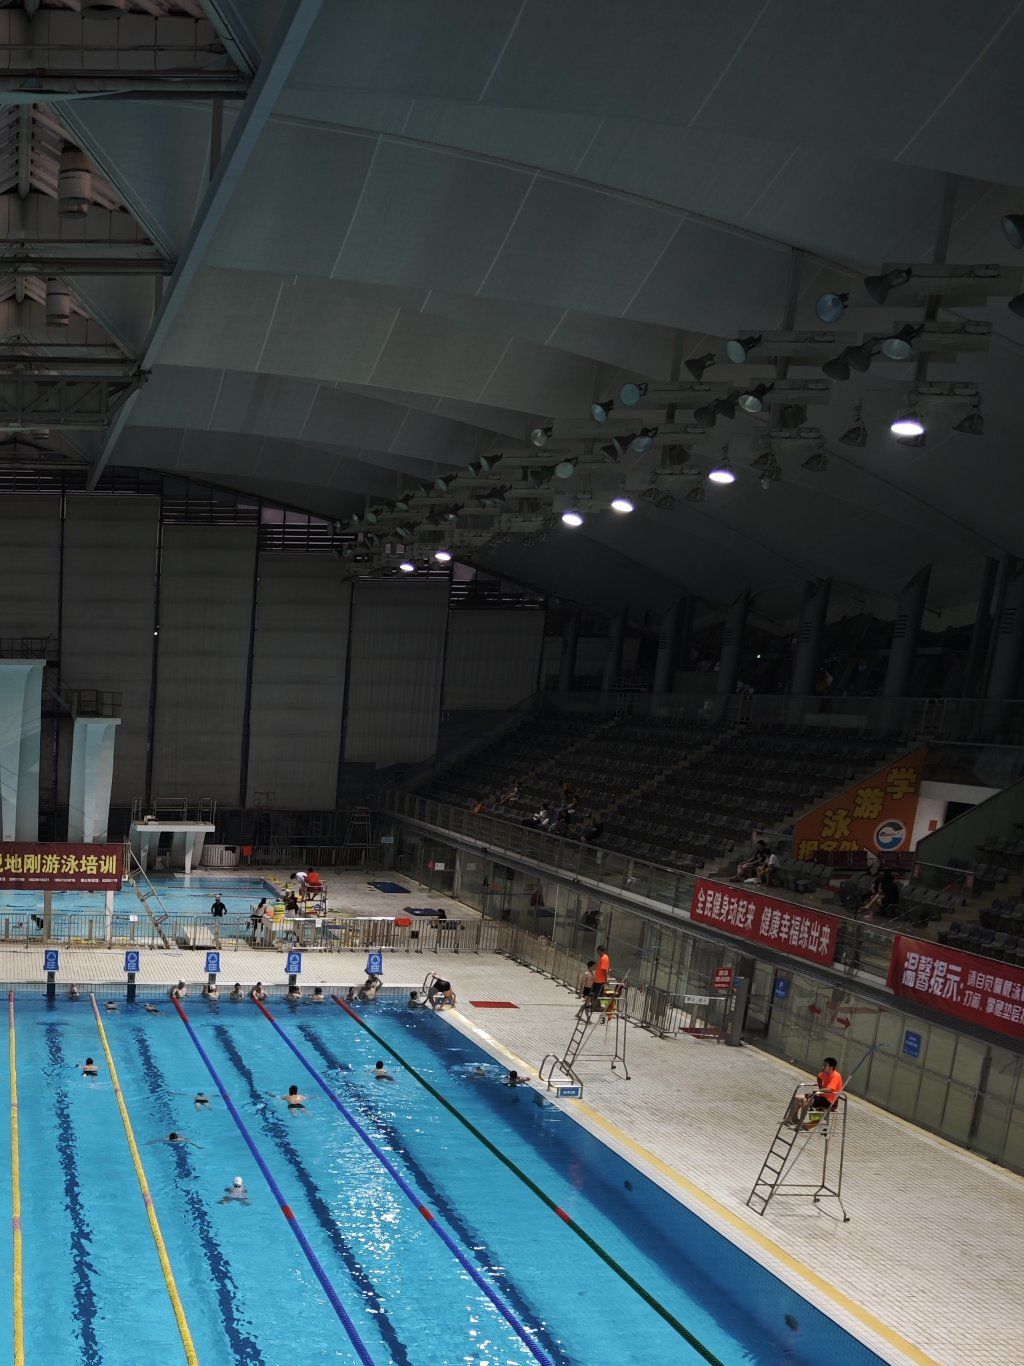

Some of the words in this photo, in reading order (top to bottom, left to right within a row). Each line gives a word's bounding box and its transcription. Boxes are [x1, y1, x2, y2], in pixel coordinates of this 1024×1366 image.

[696, 888, 756, 931] 全民健身动起来
[759, 906, 831, 955] 健康幸福练出来
[967, 969, 1024, 1001] 请自觉佩戴泳
